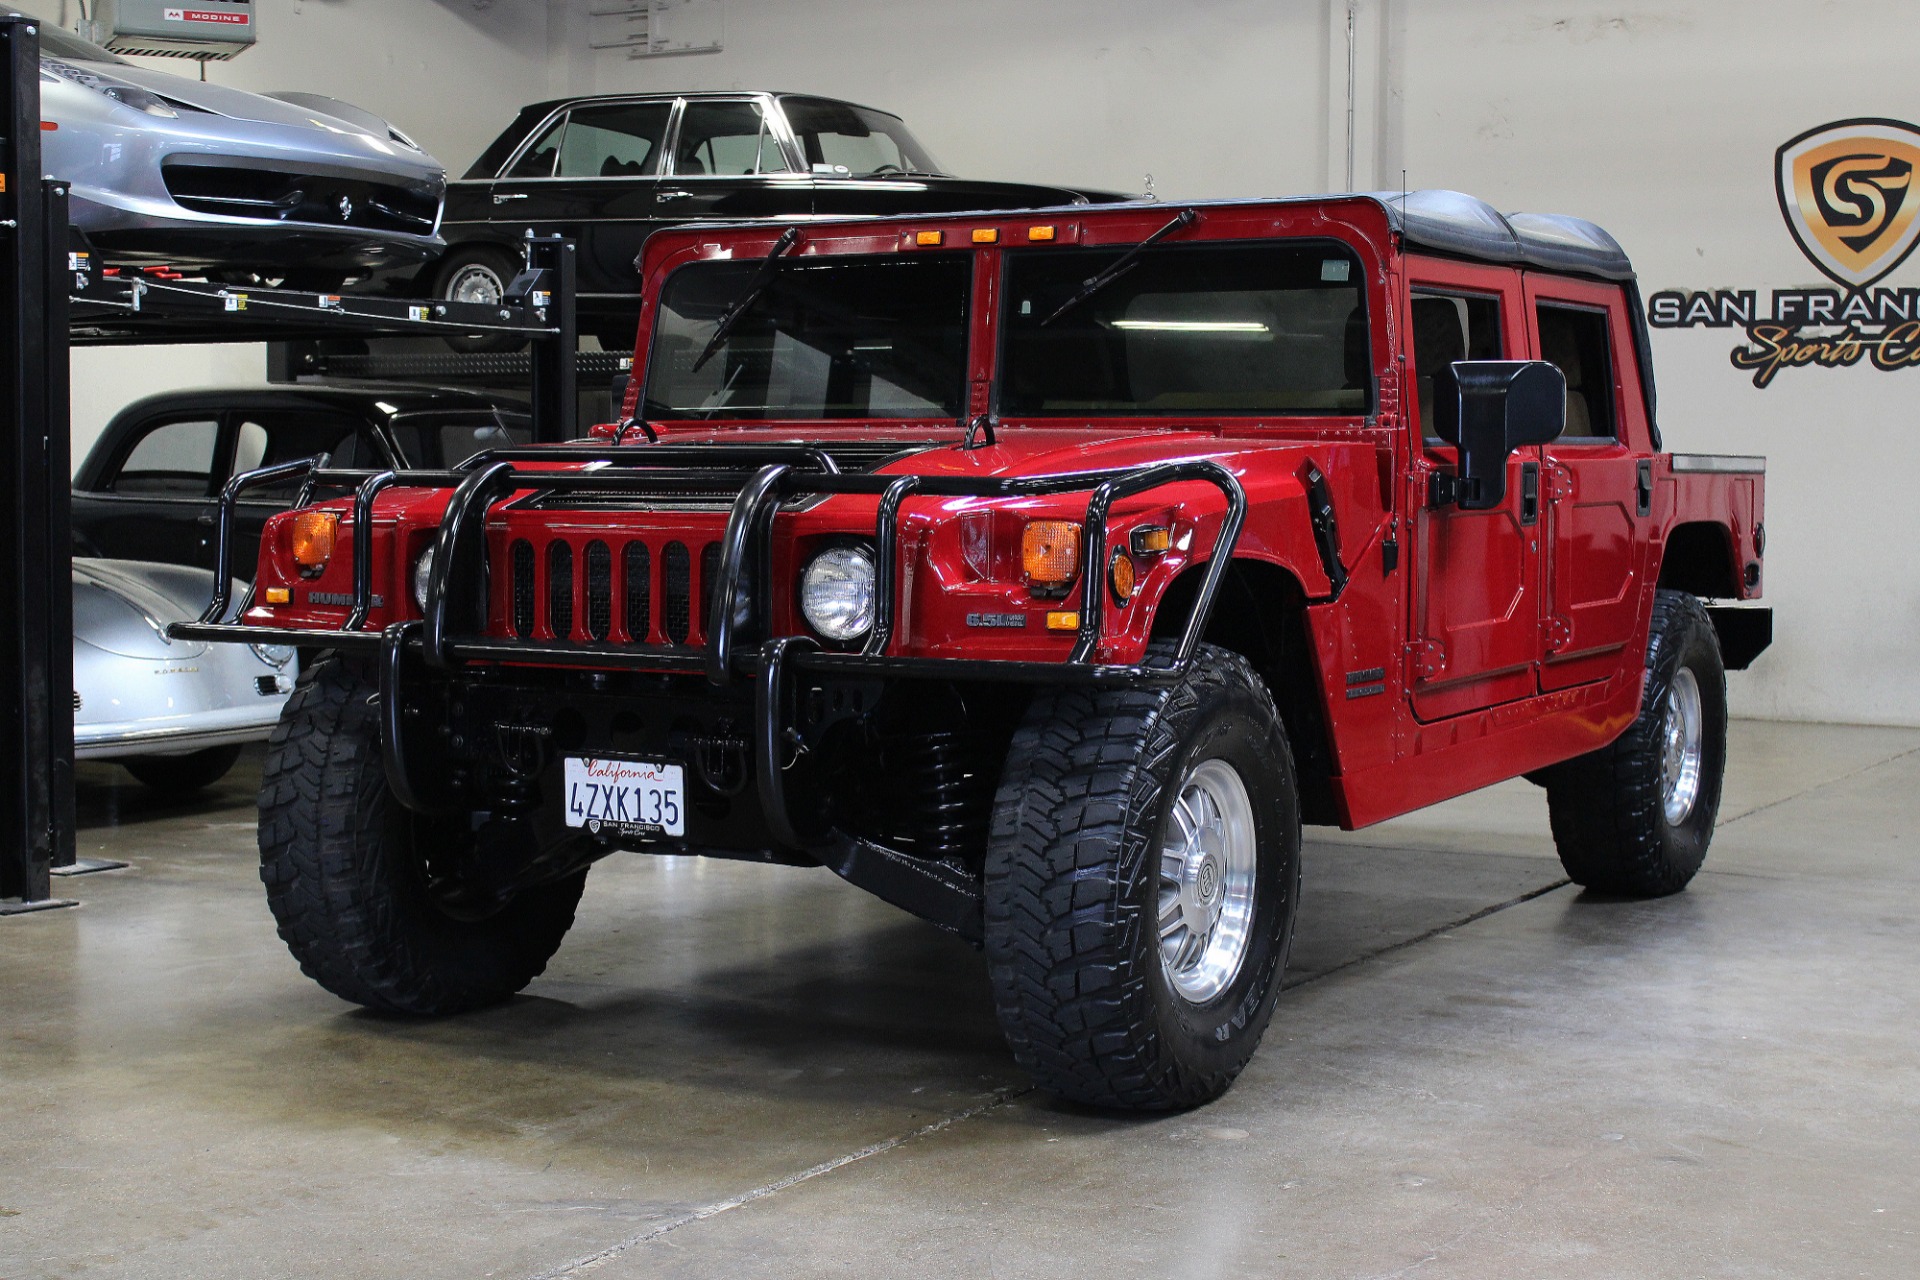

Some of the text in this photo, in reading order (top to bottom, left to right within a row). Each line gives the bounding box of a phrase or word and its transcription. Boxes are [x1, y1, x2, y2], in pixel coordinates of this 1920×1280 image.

[191, 13, 240, 22] MODINE
[1653, 294, 1920, 323] SAN FRAN
[1736, 325, 1861, 384] Sports
[588, 760, 663, 783] California
[570, 782, 678, 826] 4ZXK135
